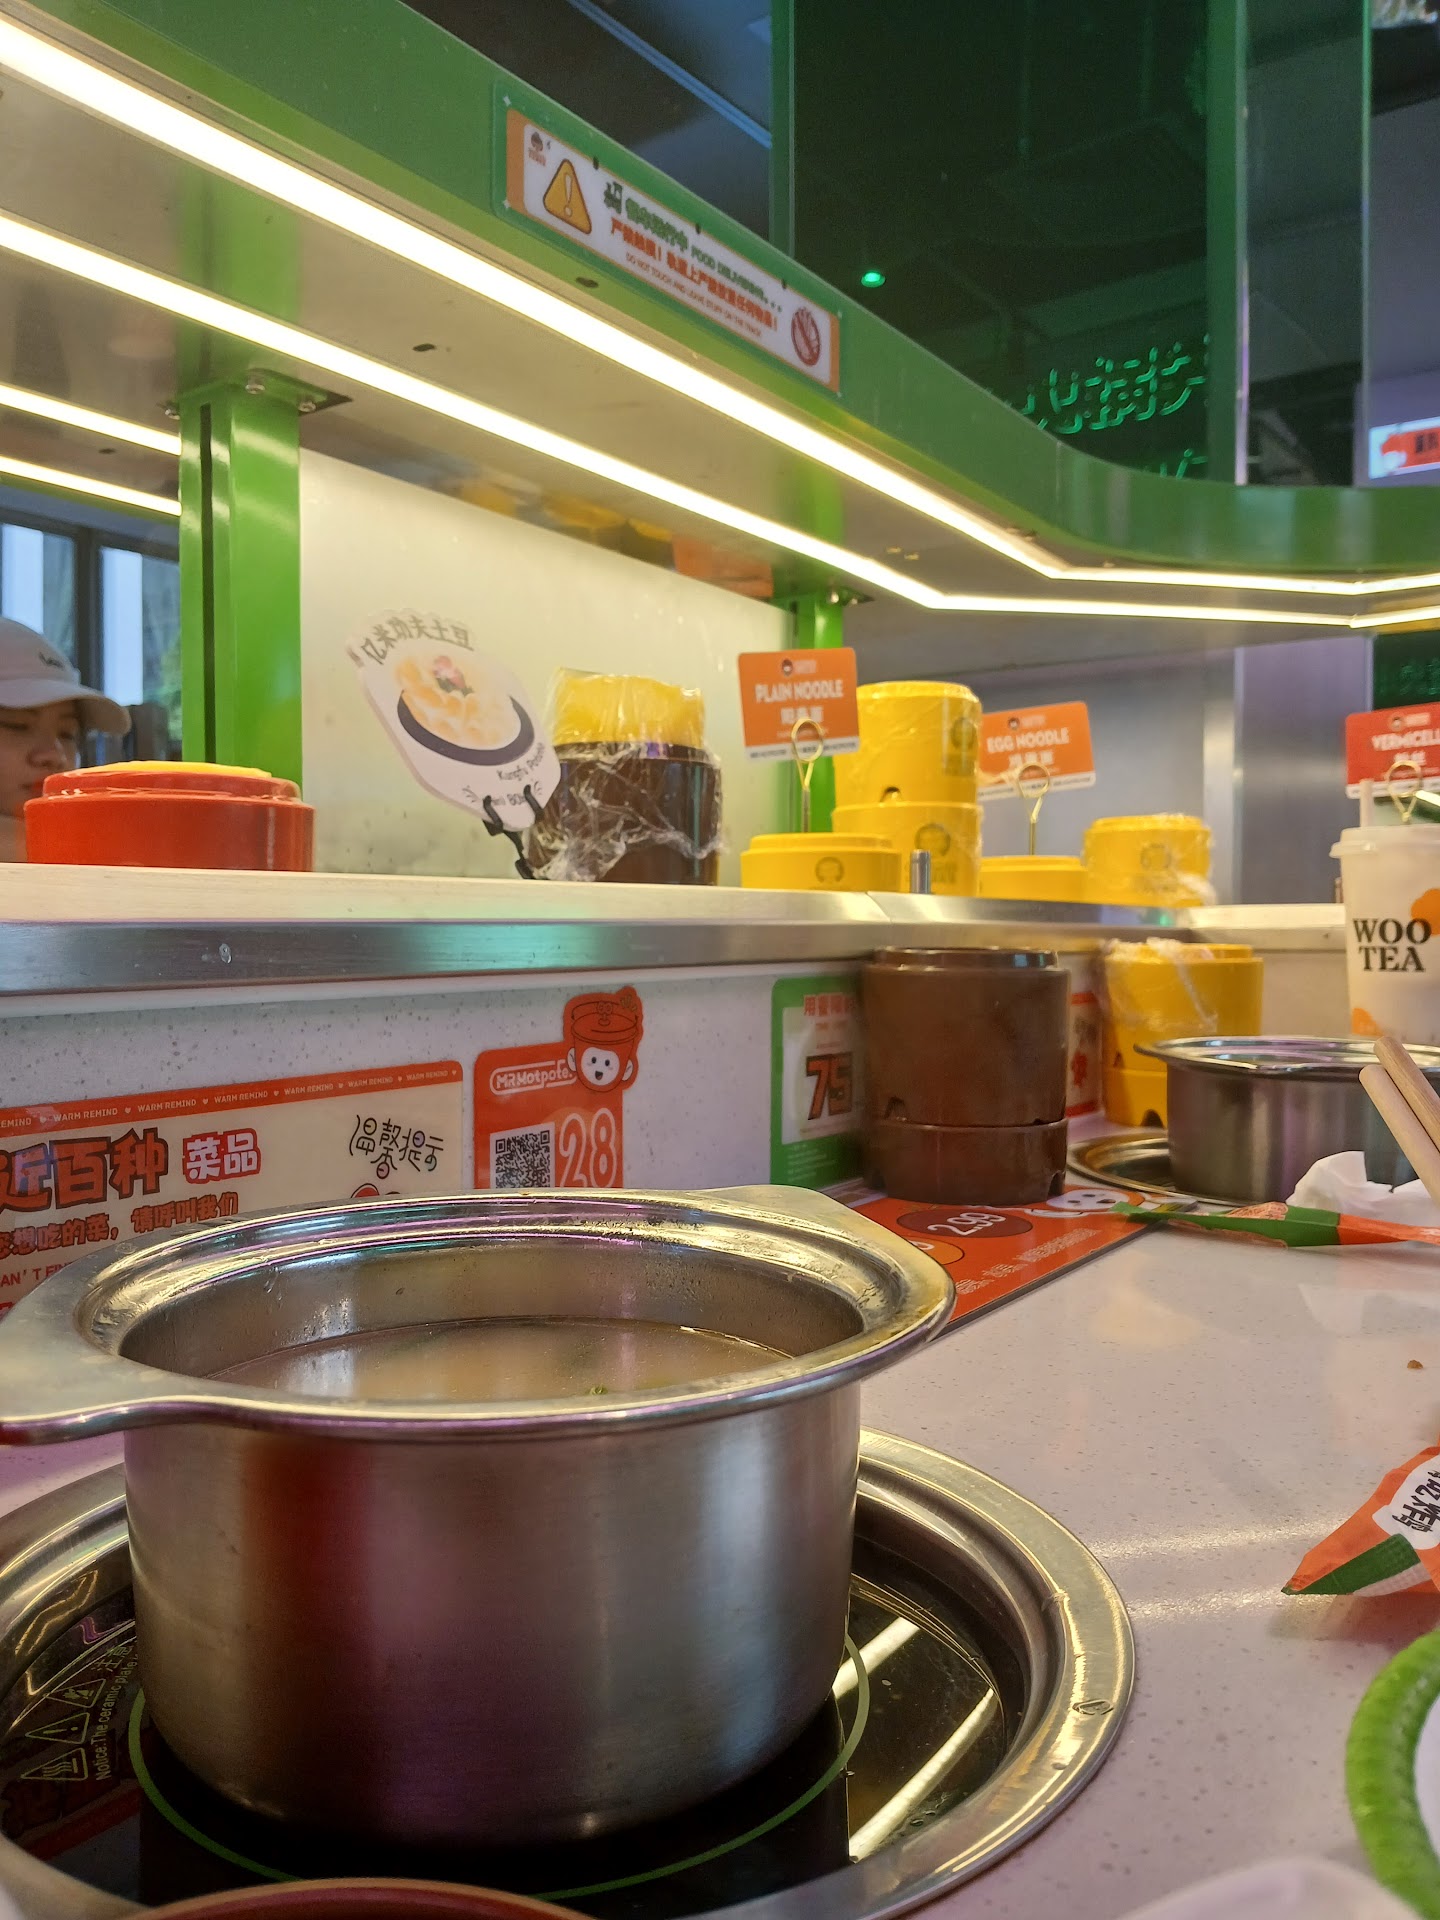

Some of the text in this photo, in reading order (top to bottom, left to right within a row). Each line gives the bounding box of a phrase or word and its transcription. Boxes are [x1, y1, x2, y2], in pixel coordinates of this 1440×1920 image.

[755, 679, 844, 703] PLAIN NOODLE
[986, 727, 1070, 754] EGG NOODLE
[1352, 918, 1432, 945] WOO
[1358, 946, 1426, 972] TEA
[0, 1070, 449, 1128] EMIND WARM REMIND WARM REMIND WARM REMIND WARM REMIND WARM REMIND WARM REMIND
[805, 1051, 853, 1121] 75
[559, 1108, 617, 1188] 28
[0, 1128, 260, 1213] 近百种 菜品
[98, 1684, 122, 1723] ceramic
